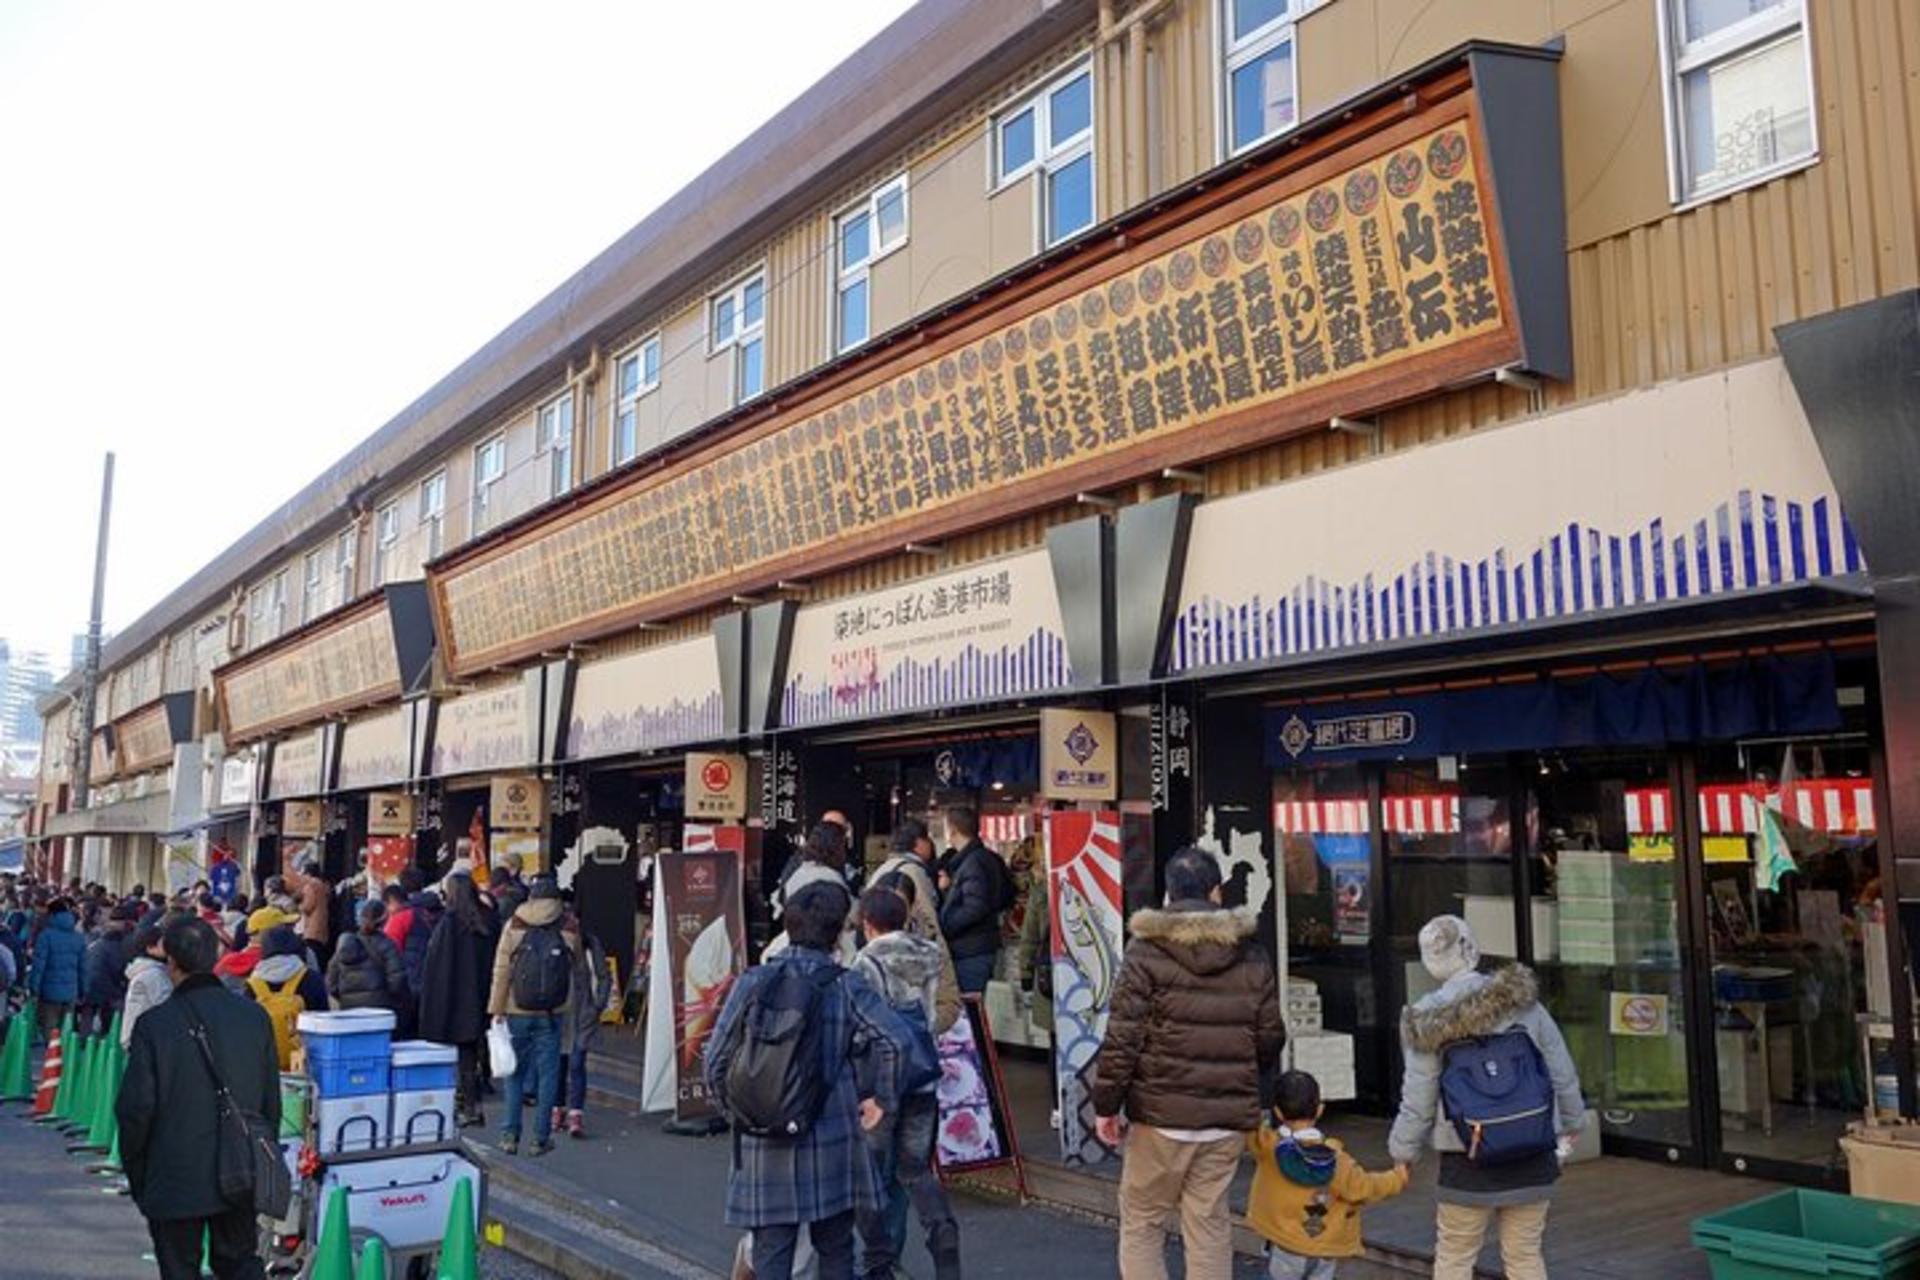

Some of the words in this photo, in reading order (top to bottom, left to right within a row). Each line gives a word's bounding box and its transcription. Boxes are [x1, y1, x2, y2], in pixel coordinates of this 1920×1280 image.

[1396, 202, 1453, 342] 山伝
[1208, 279, 1256, 405] 吉岡屋
[834, 570, 1012, 641] 築地にっぽん漁港市場
[1168, 704, 1190, 778] 静岡
[777, 749, 798, 823] 北海道
